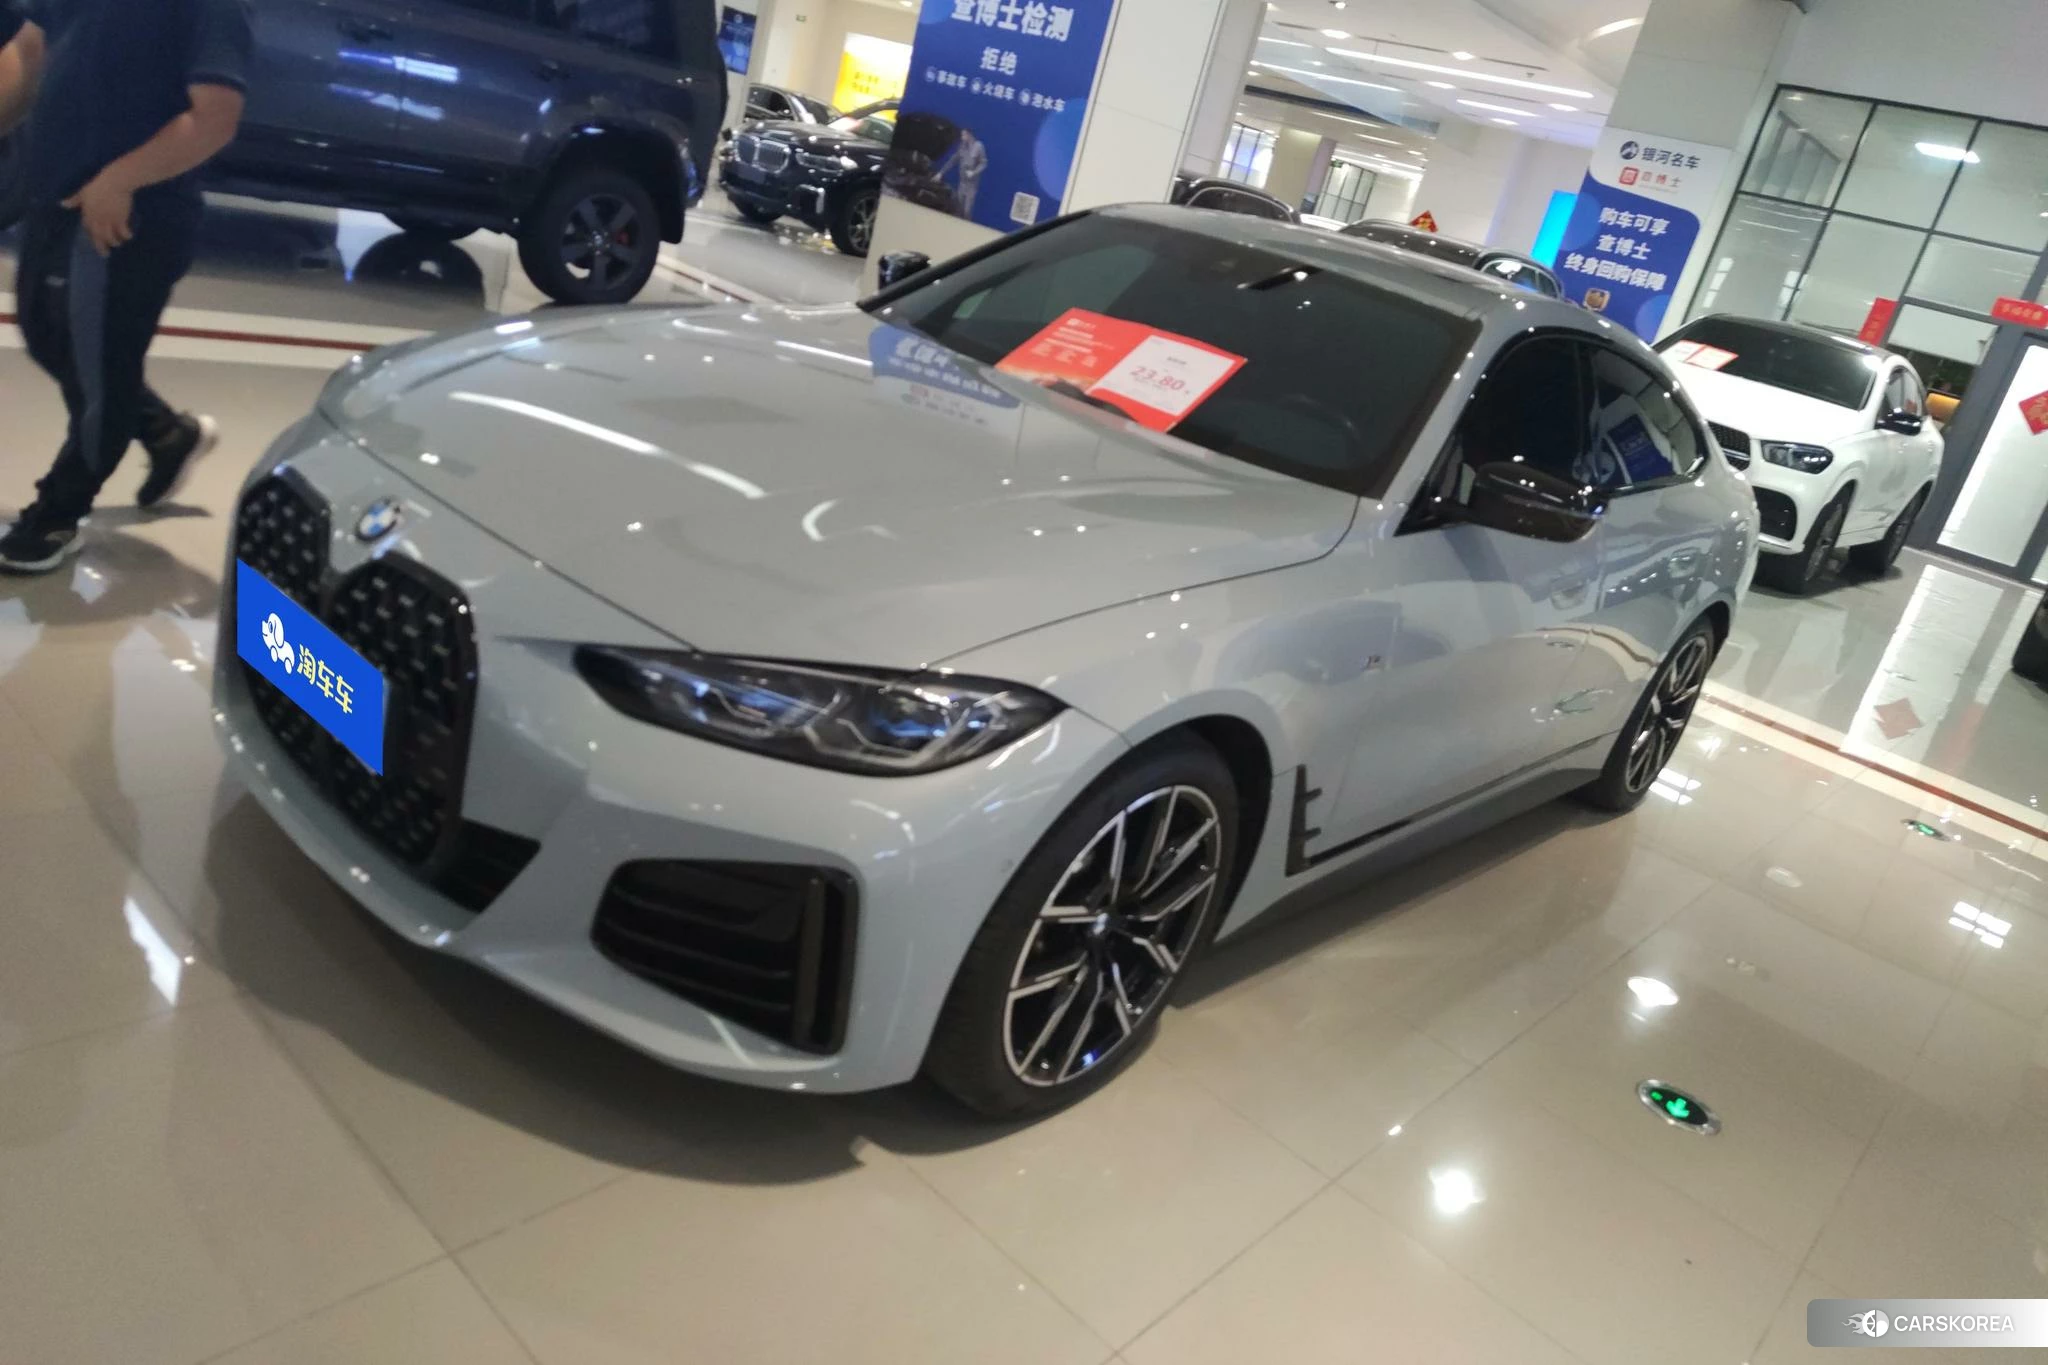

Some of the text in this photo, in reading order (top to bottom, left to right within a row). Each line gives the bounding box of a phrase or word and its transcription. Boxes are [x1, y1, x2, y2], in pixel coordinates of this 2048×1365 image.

[979, 46, 1018, 76] 拒绝
[1641, 147, 1701, 169] 银河名车
[1598, 207, 1671, 236] 购车可享
[1596, 234, 1652, 260] 查博士
[1563, 252, 1668, 292] 终身回购保障
